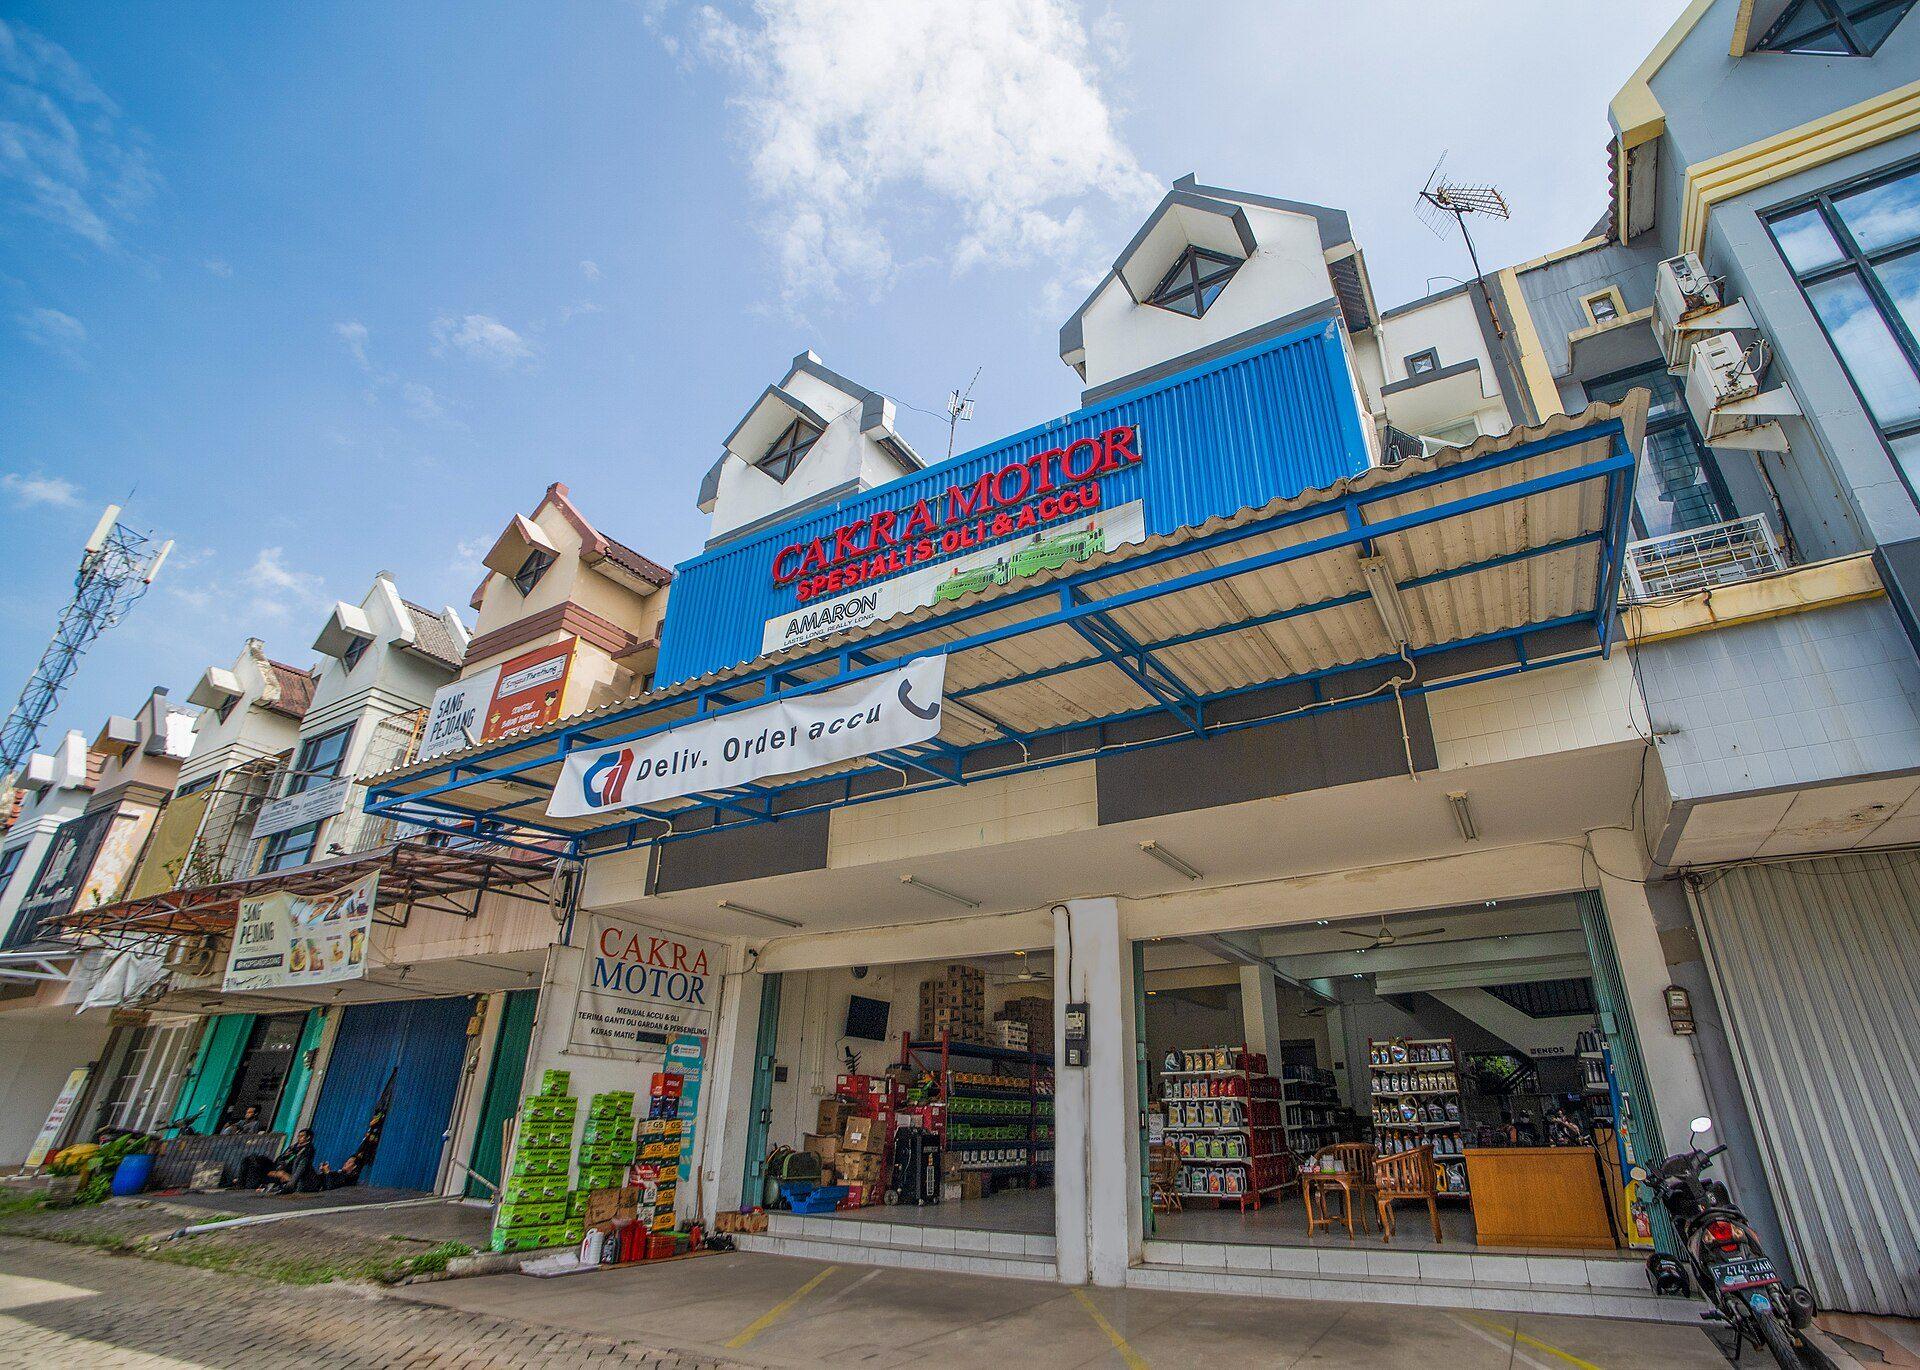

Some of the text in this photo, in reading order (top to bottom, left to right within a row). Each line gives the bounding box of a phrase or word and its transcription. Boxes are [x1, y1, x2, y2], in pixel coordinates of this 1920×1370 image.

[772, 424, 1142, 585] CAKRA MOTOR
[796, 481, 1101, 602] SPESIALIS OLI & ACCU
[783, 636, 804, 646] LASTS
[827, 620, 853, 632] REALLY
[785, 591, 877, 638] AMARON
[437, 692, 465, 719] SANG
[636, 703, 881, 782] Deliv. Order accu
[599, 927, 710, 976] CAKRA
[591, 957, 705, 1005] MOTOR
[578, 1011, 603, 1022] TERIMA
[604, 1015, 625, 1025] GANTI
[626, 1018, 637, 1026] OLI
[637, 1020, 663, 1030] GARDAN
[669, 1023, 708, 1035] PERSENELING
[616, 1006, 646, 1017] MENJUAL
[646, 1011, 664, 1020] ACCU
[591, 1027, 635, 1039] KURAS MATIC
[1537, 1046, 1564, 1054] ENEOS
